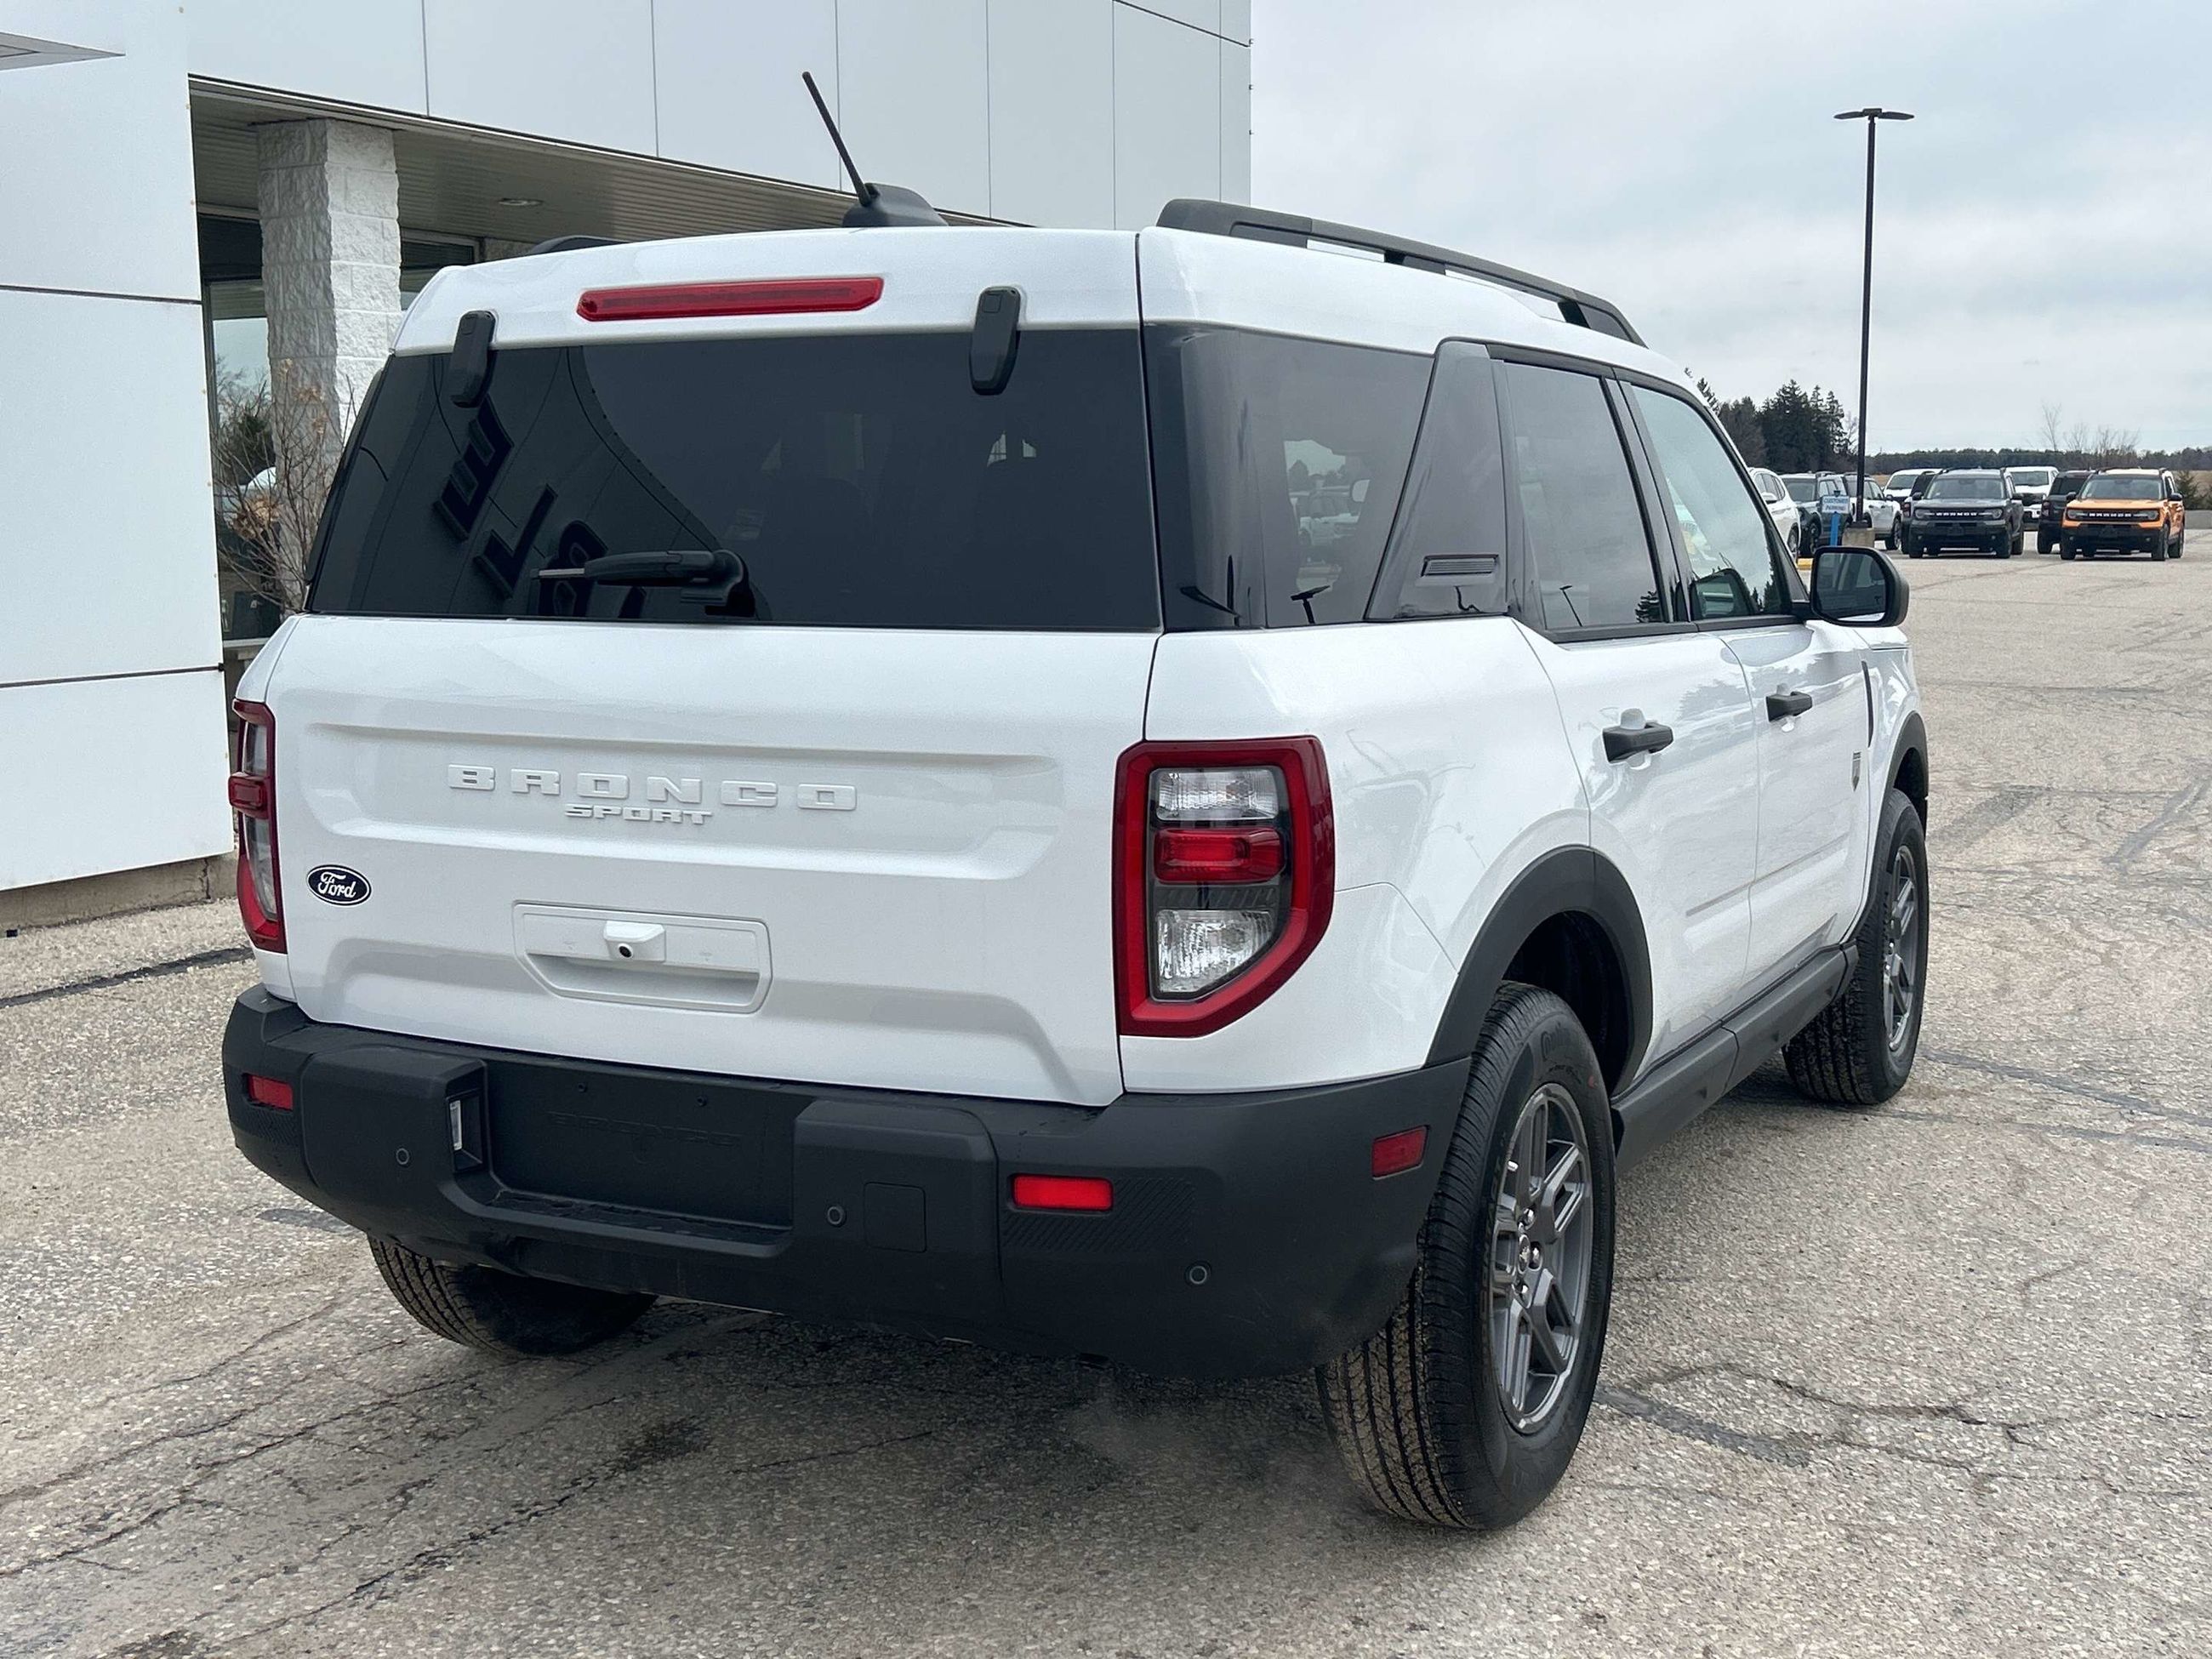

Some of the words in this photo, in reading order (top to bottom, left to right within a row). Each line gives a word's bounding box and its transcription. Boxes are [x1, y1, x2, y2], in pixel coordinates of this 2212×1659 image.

[448, 764, 858, 811] BRONCO
[565, 803, 713, 824] SPORT
[317, 871, 356, 898] Ford
